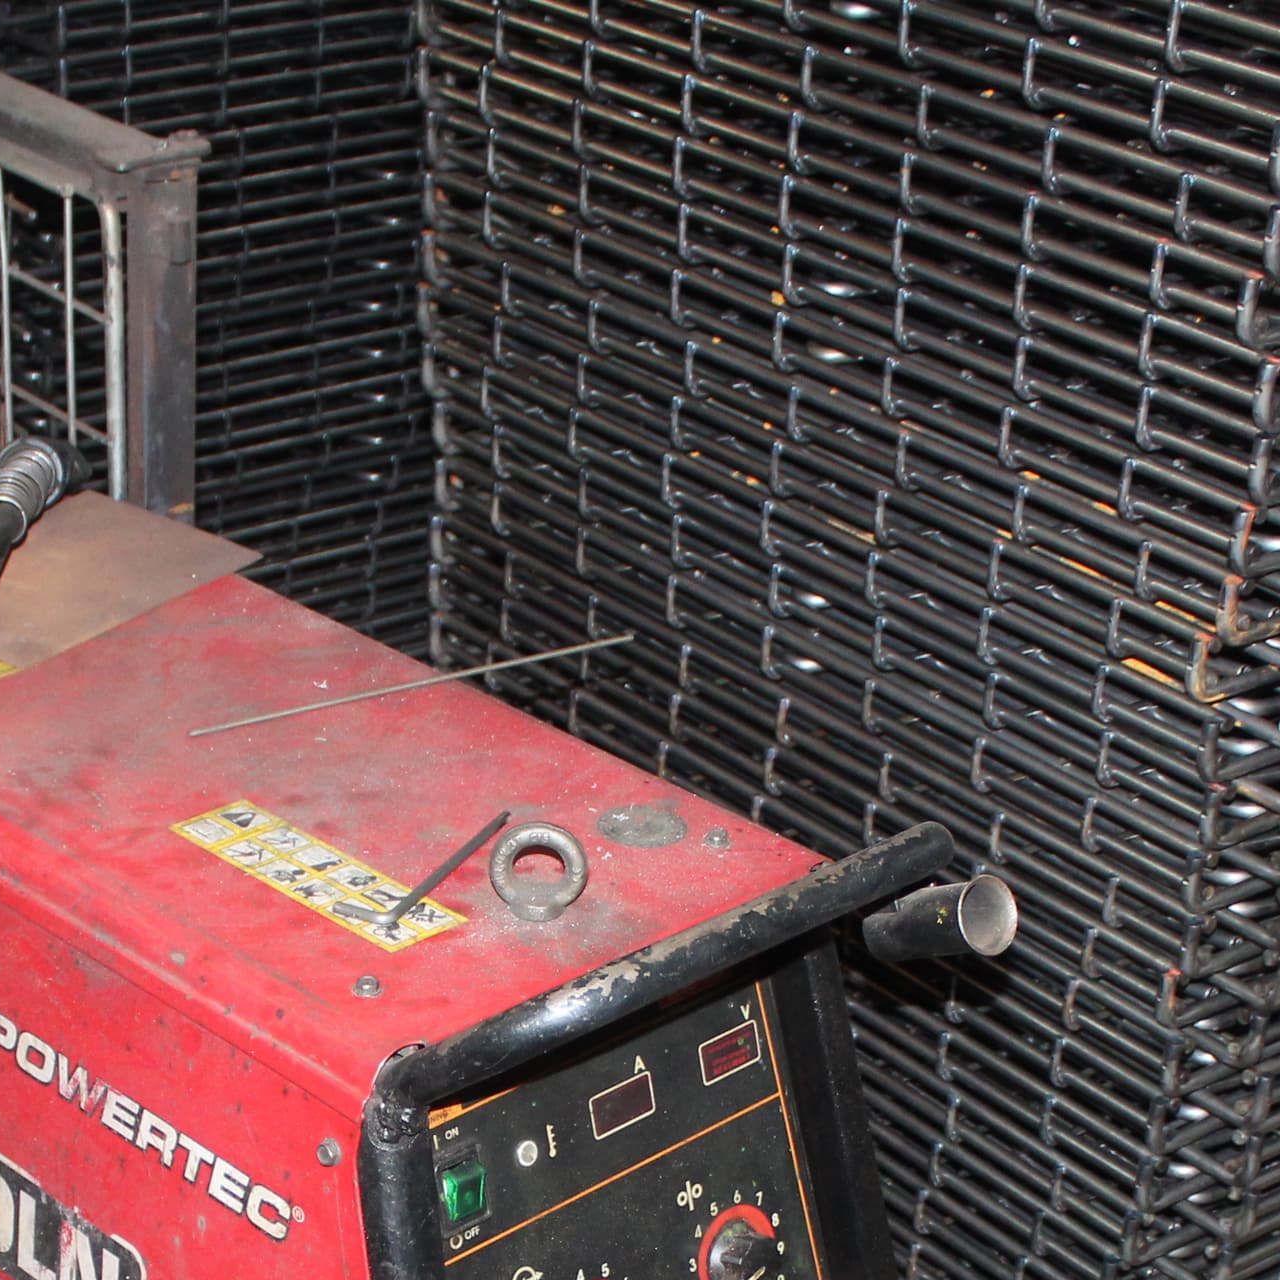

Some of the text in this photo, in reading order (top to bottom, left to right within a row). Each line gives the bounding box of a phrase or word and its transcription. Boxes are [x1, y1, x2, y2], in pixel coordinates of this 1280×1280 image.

[739, 1003, 751, 1021] V
[633, 1055, 646, 1074] A
[444, 1126, 460, 1141] ON
[733, 1189, 742, 1204] 6
[755, 1191, 764, 1206] 7
[709, 1201, 718, 1216] 5
[771, 1212, 780, 1227] 8
[464, 1225, 481, 1241] OFF
[694, 1224, 703, 1239] 4
[776, 1241, 785, 1255] 9
[601, 1263, 610, 1278] 5
[688, 1258, 697, 1273] 3
